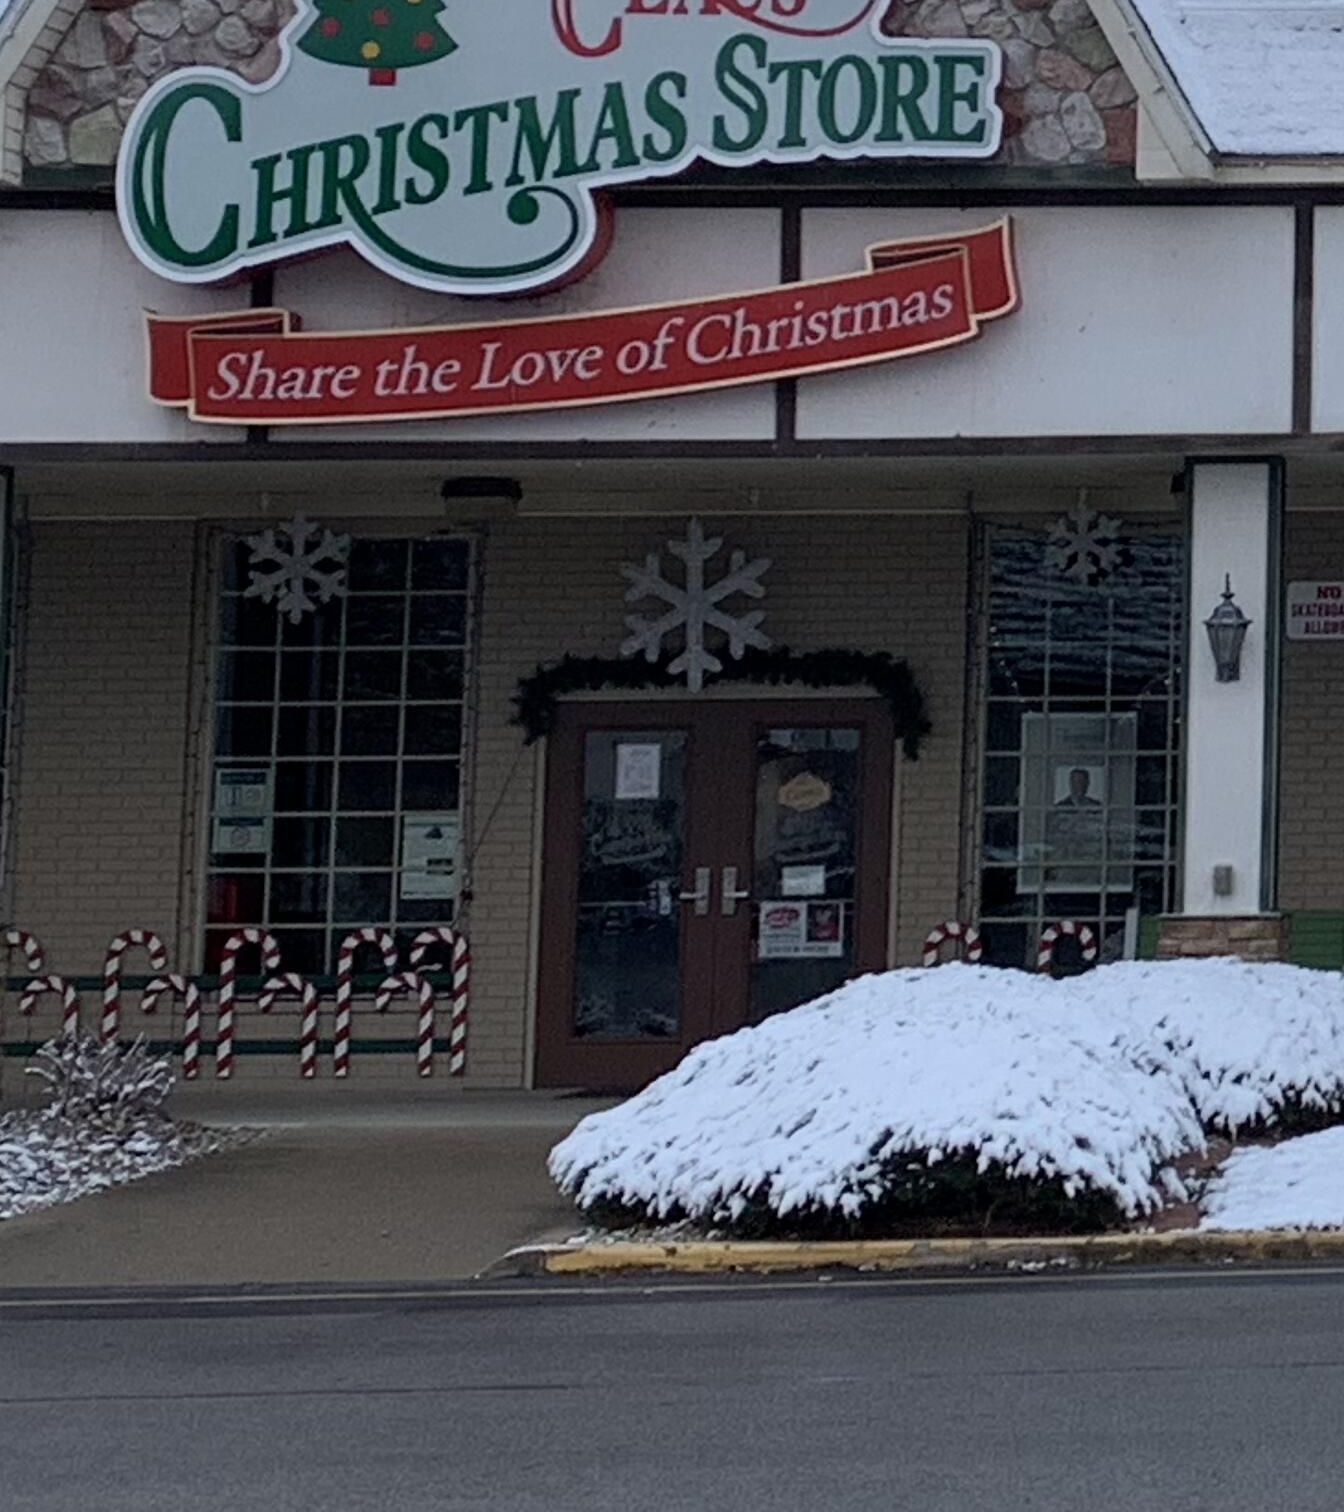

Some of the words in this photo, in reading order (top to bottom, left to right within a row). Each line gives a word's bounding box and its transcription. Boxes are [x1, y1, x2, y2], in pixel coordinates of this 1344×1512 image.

[132, 71, 688, 276] CHRISTMAS
[712, 33, 987, 152] STORE
[207, 352, 361, 402] Share
[373, 344, 462, 395] the
[470, 341, 604, 391] Love
[616, 315, 681, 373] of
[684, 283, 955, 367] Christmas
[1317, 586, 1342, 599] NO
